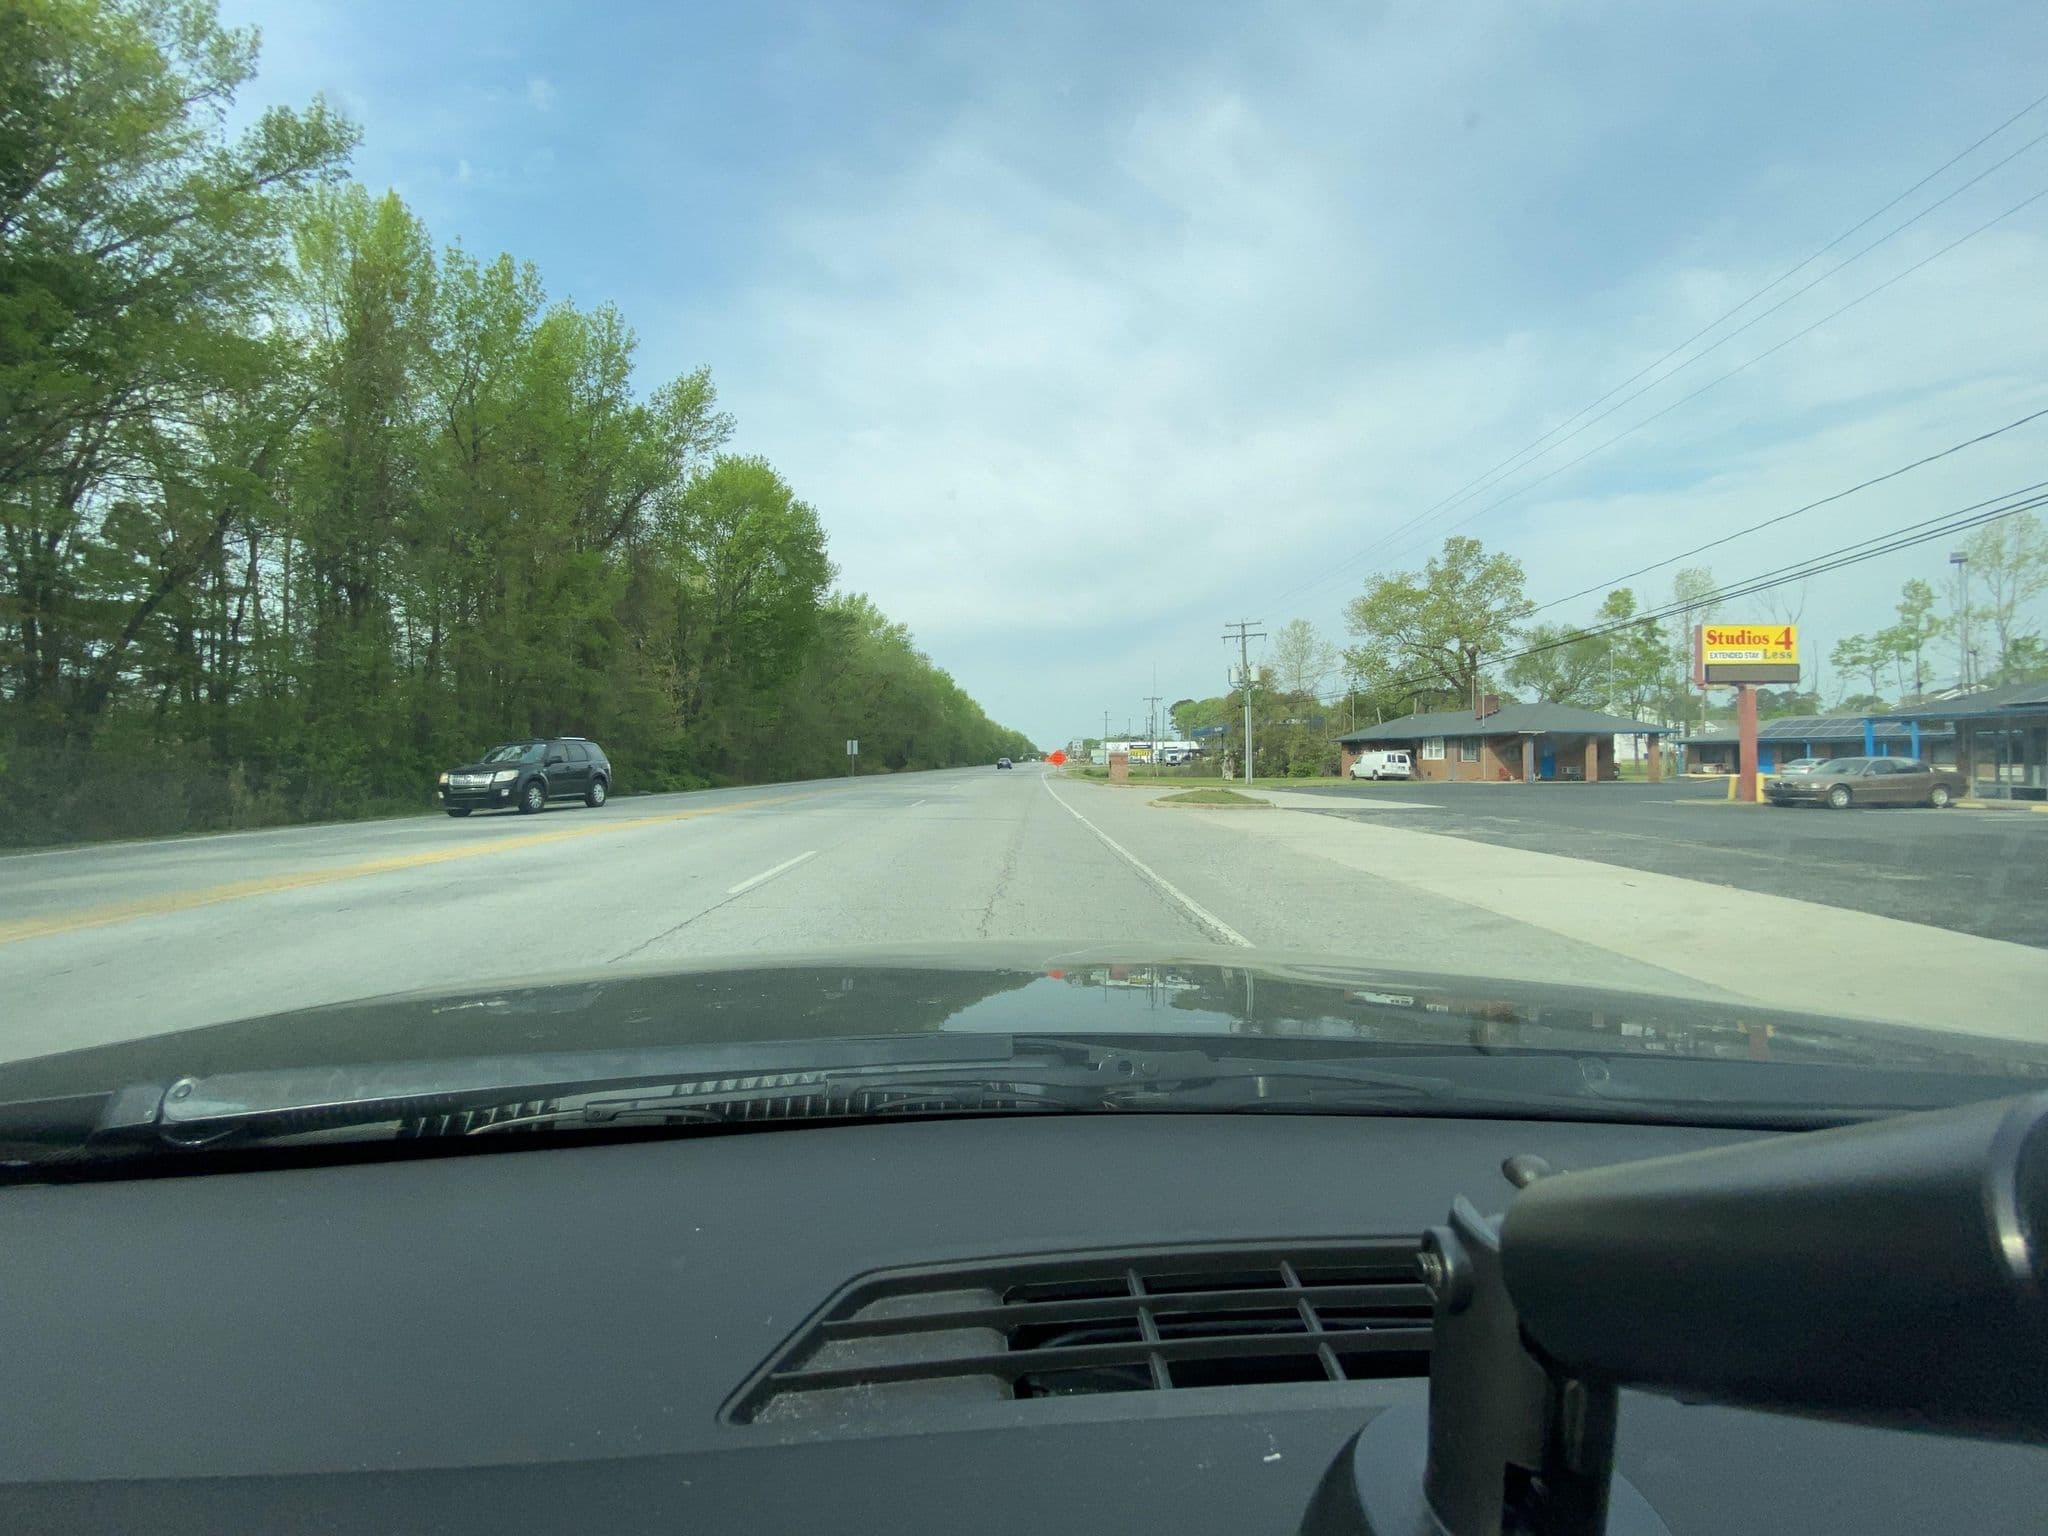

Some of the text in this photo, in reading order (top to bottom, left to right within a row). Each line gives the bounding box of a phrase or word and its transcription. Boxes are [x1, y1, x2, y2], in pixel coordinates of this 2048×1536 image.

[1706, 626, 1793, 651] Studios 4
[1709, 652, 1760, 660] EXTENDED STAY
[1763, 649, 1793, 660] Less
